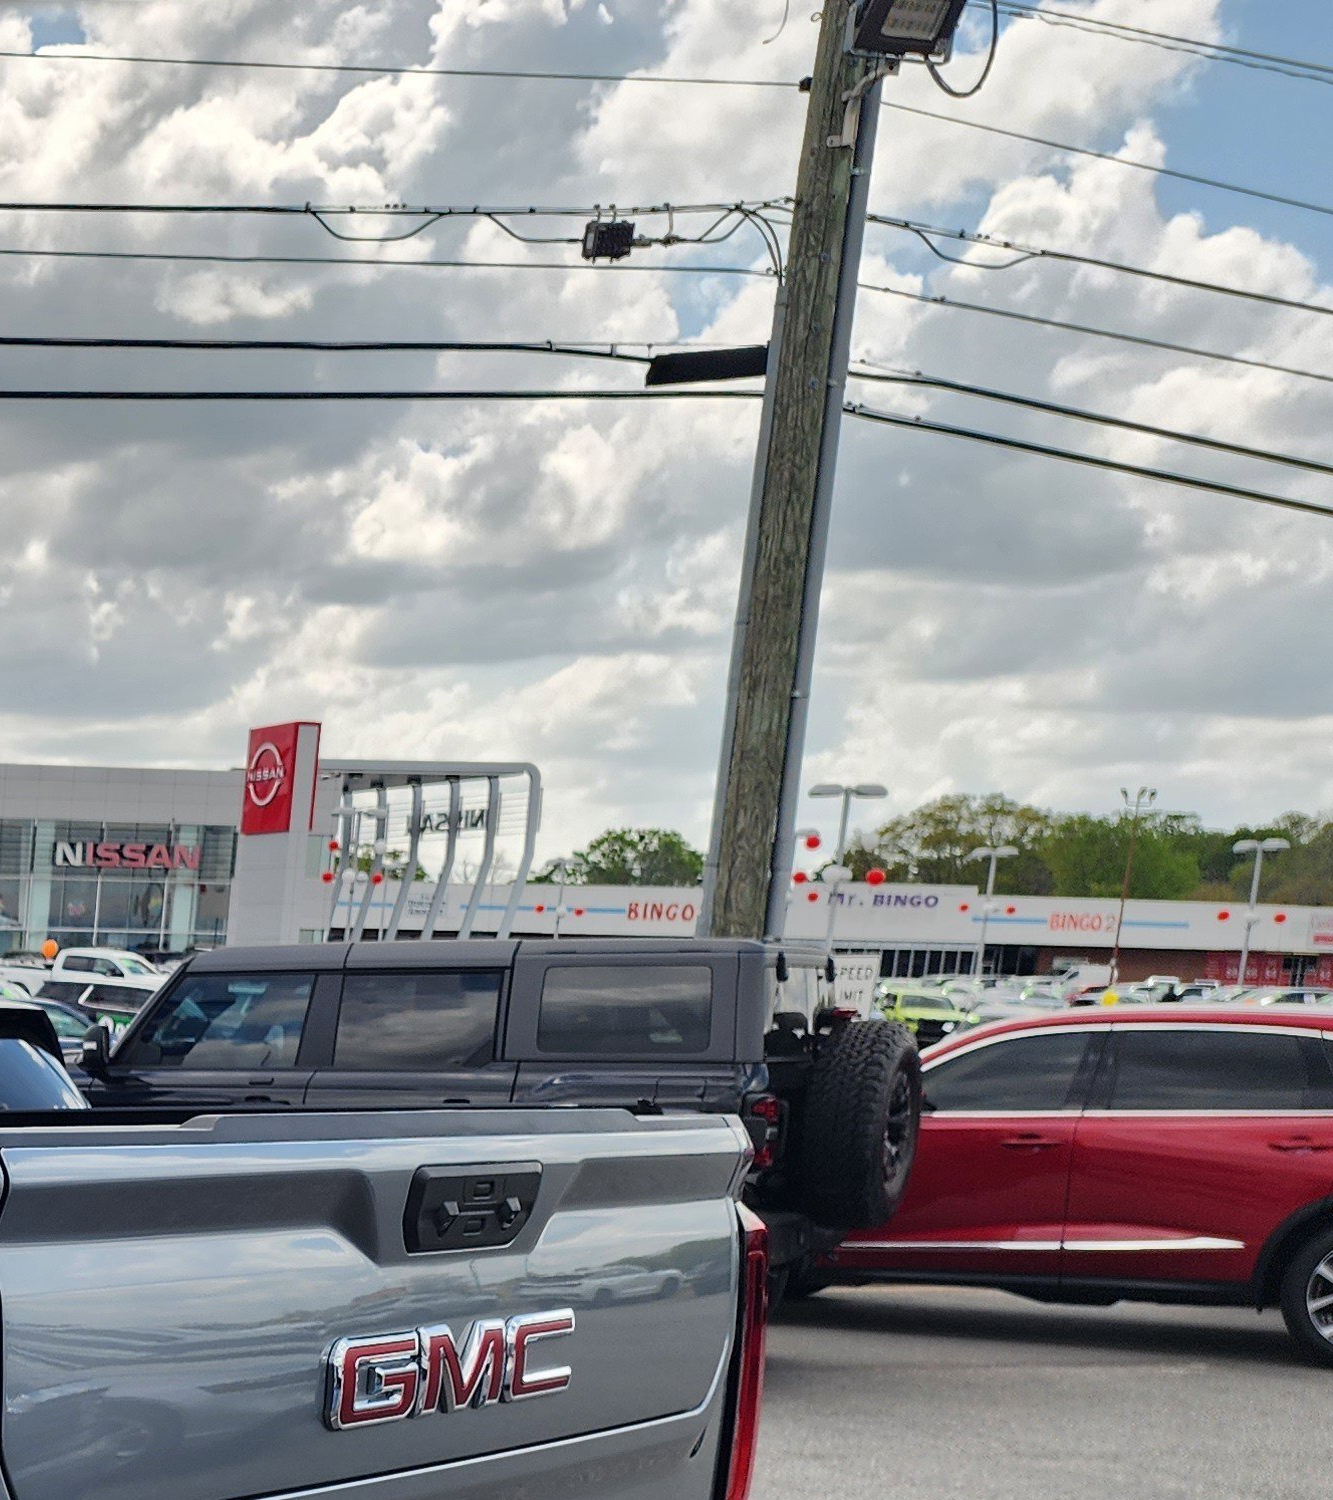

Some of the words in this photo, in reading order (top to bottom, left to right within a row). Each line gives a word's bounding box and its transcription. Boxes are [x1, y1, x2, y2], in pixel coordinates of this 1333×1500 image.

[246, 764, 284, 782] NISSAN
[55, 841, 202, 870] NISSAN
[872, 894, 939, 908] BINGO
[627, 902, 695, 922] BINGO
[1048, 912, 1102, 932] BINGO
[837, 967, 873, 980] PEED
[319, 1308, 575, 1430] GMC
